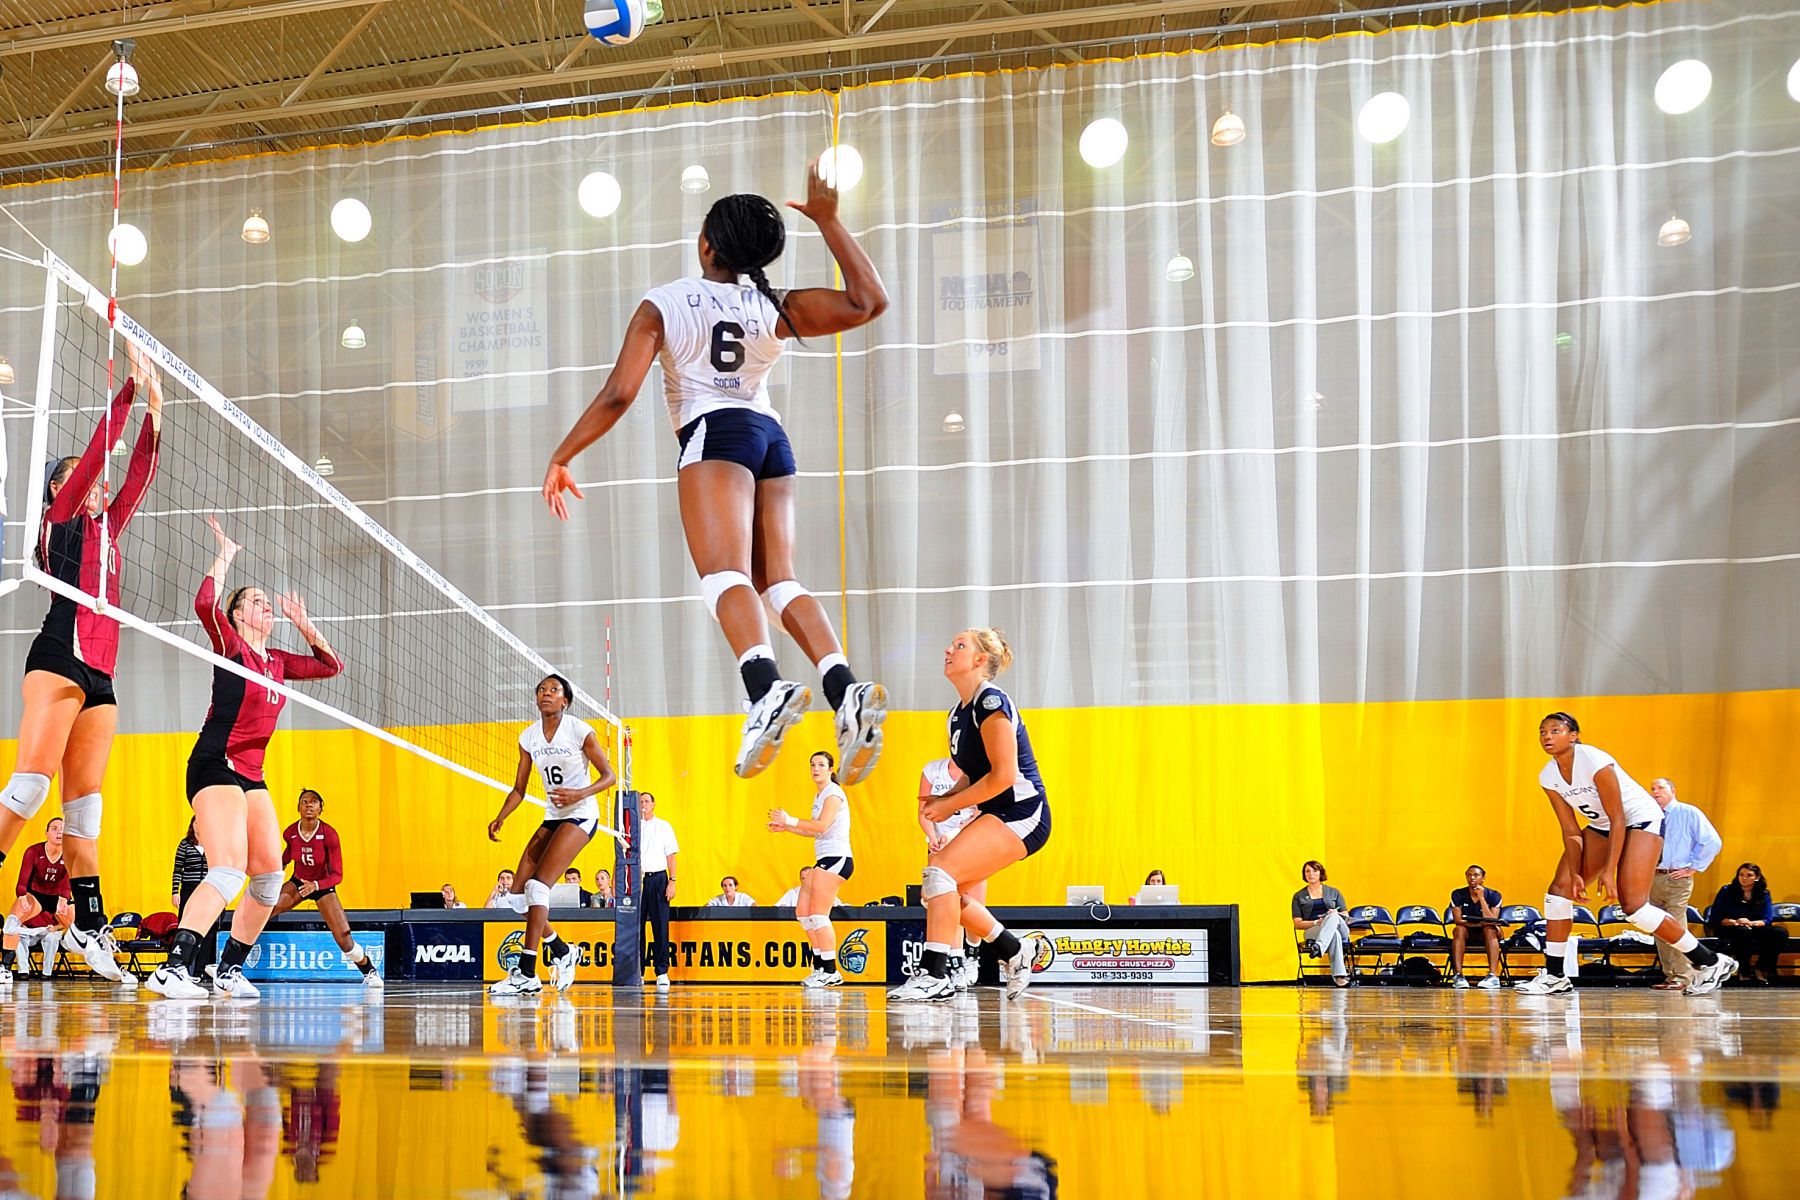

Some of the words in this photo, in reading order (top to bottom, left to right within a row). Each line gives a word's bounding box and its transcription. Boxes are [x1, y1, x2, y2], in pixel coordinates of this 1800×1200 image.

[942, 295, 1033, 311] TOURNAMENT
[466, 307, 534, 324] WOMEN'S
[459, 321, 540, 338] BASKETBALL
[122, 315, 158, 353] SPARTAN
[161, 346, 203, 391] VOLLEYBALL
[457, 335, 542, 353] CHAMPIONS
[710, 320, 746, 372] 6
[223, 399, 251, 430] SPARTAN
[544, 765, 564, 786] 16
[1578, 804, 1600, 820] 5
[301, 854, 315, 866] 15
[415, 944, 471, 963] NCAA
[1054, 936, 1125, 957] Hungry
[1125, 937, 1193, 956] Howie's
[266, 943, 331, 970] Blue
